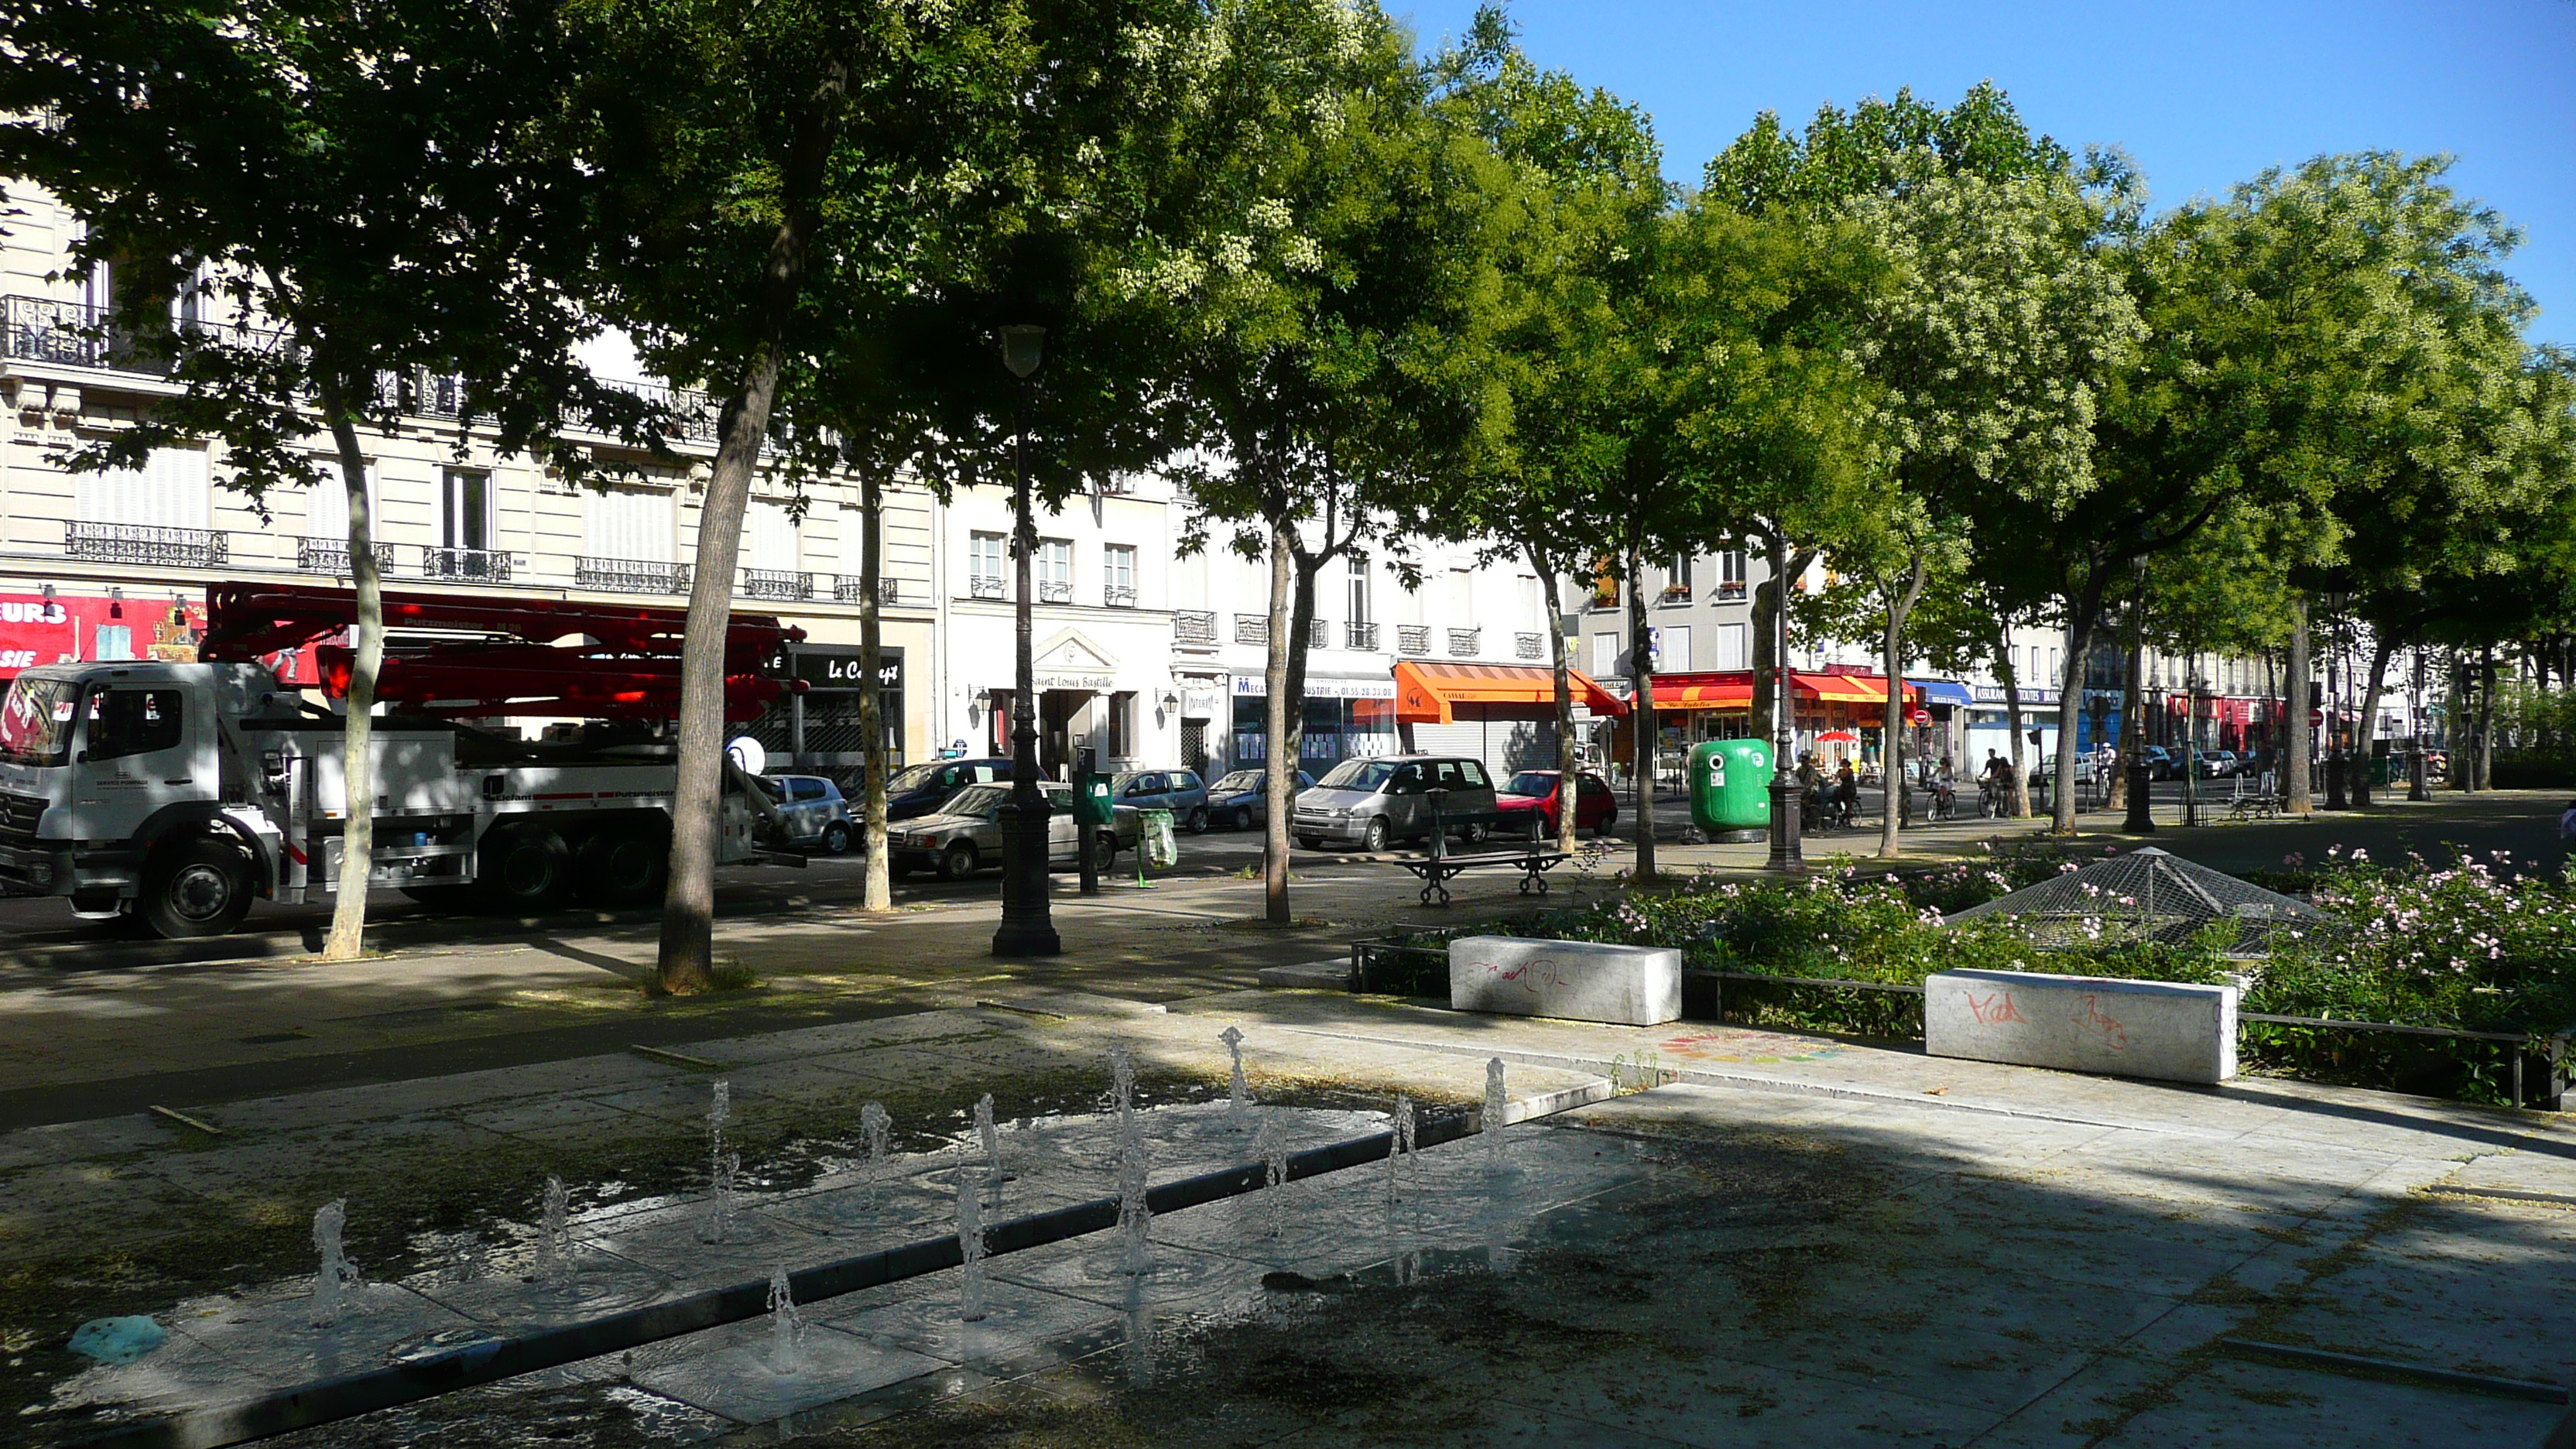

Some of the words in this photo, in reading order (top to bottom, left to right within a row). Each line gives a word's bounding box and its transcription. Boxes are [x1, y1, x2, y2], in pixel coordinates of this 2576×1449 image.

[0, 602, 67, 625] URS
[404, 618, 484, 631] Putzmeister
[497, 622, 506, 632] M
[828, 659, 843, 679] Le
[1057, 676, 1079, 687] Louis
[1082, 677, 1115, 688] Bastille
[2018, 689, 2040, 701] TOUTES
[1078, 749, 1086, 762] P
[495, 793, 533, 802] Elefant
[615, 790, 675, 799] Putzmeister
